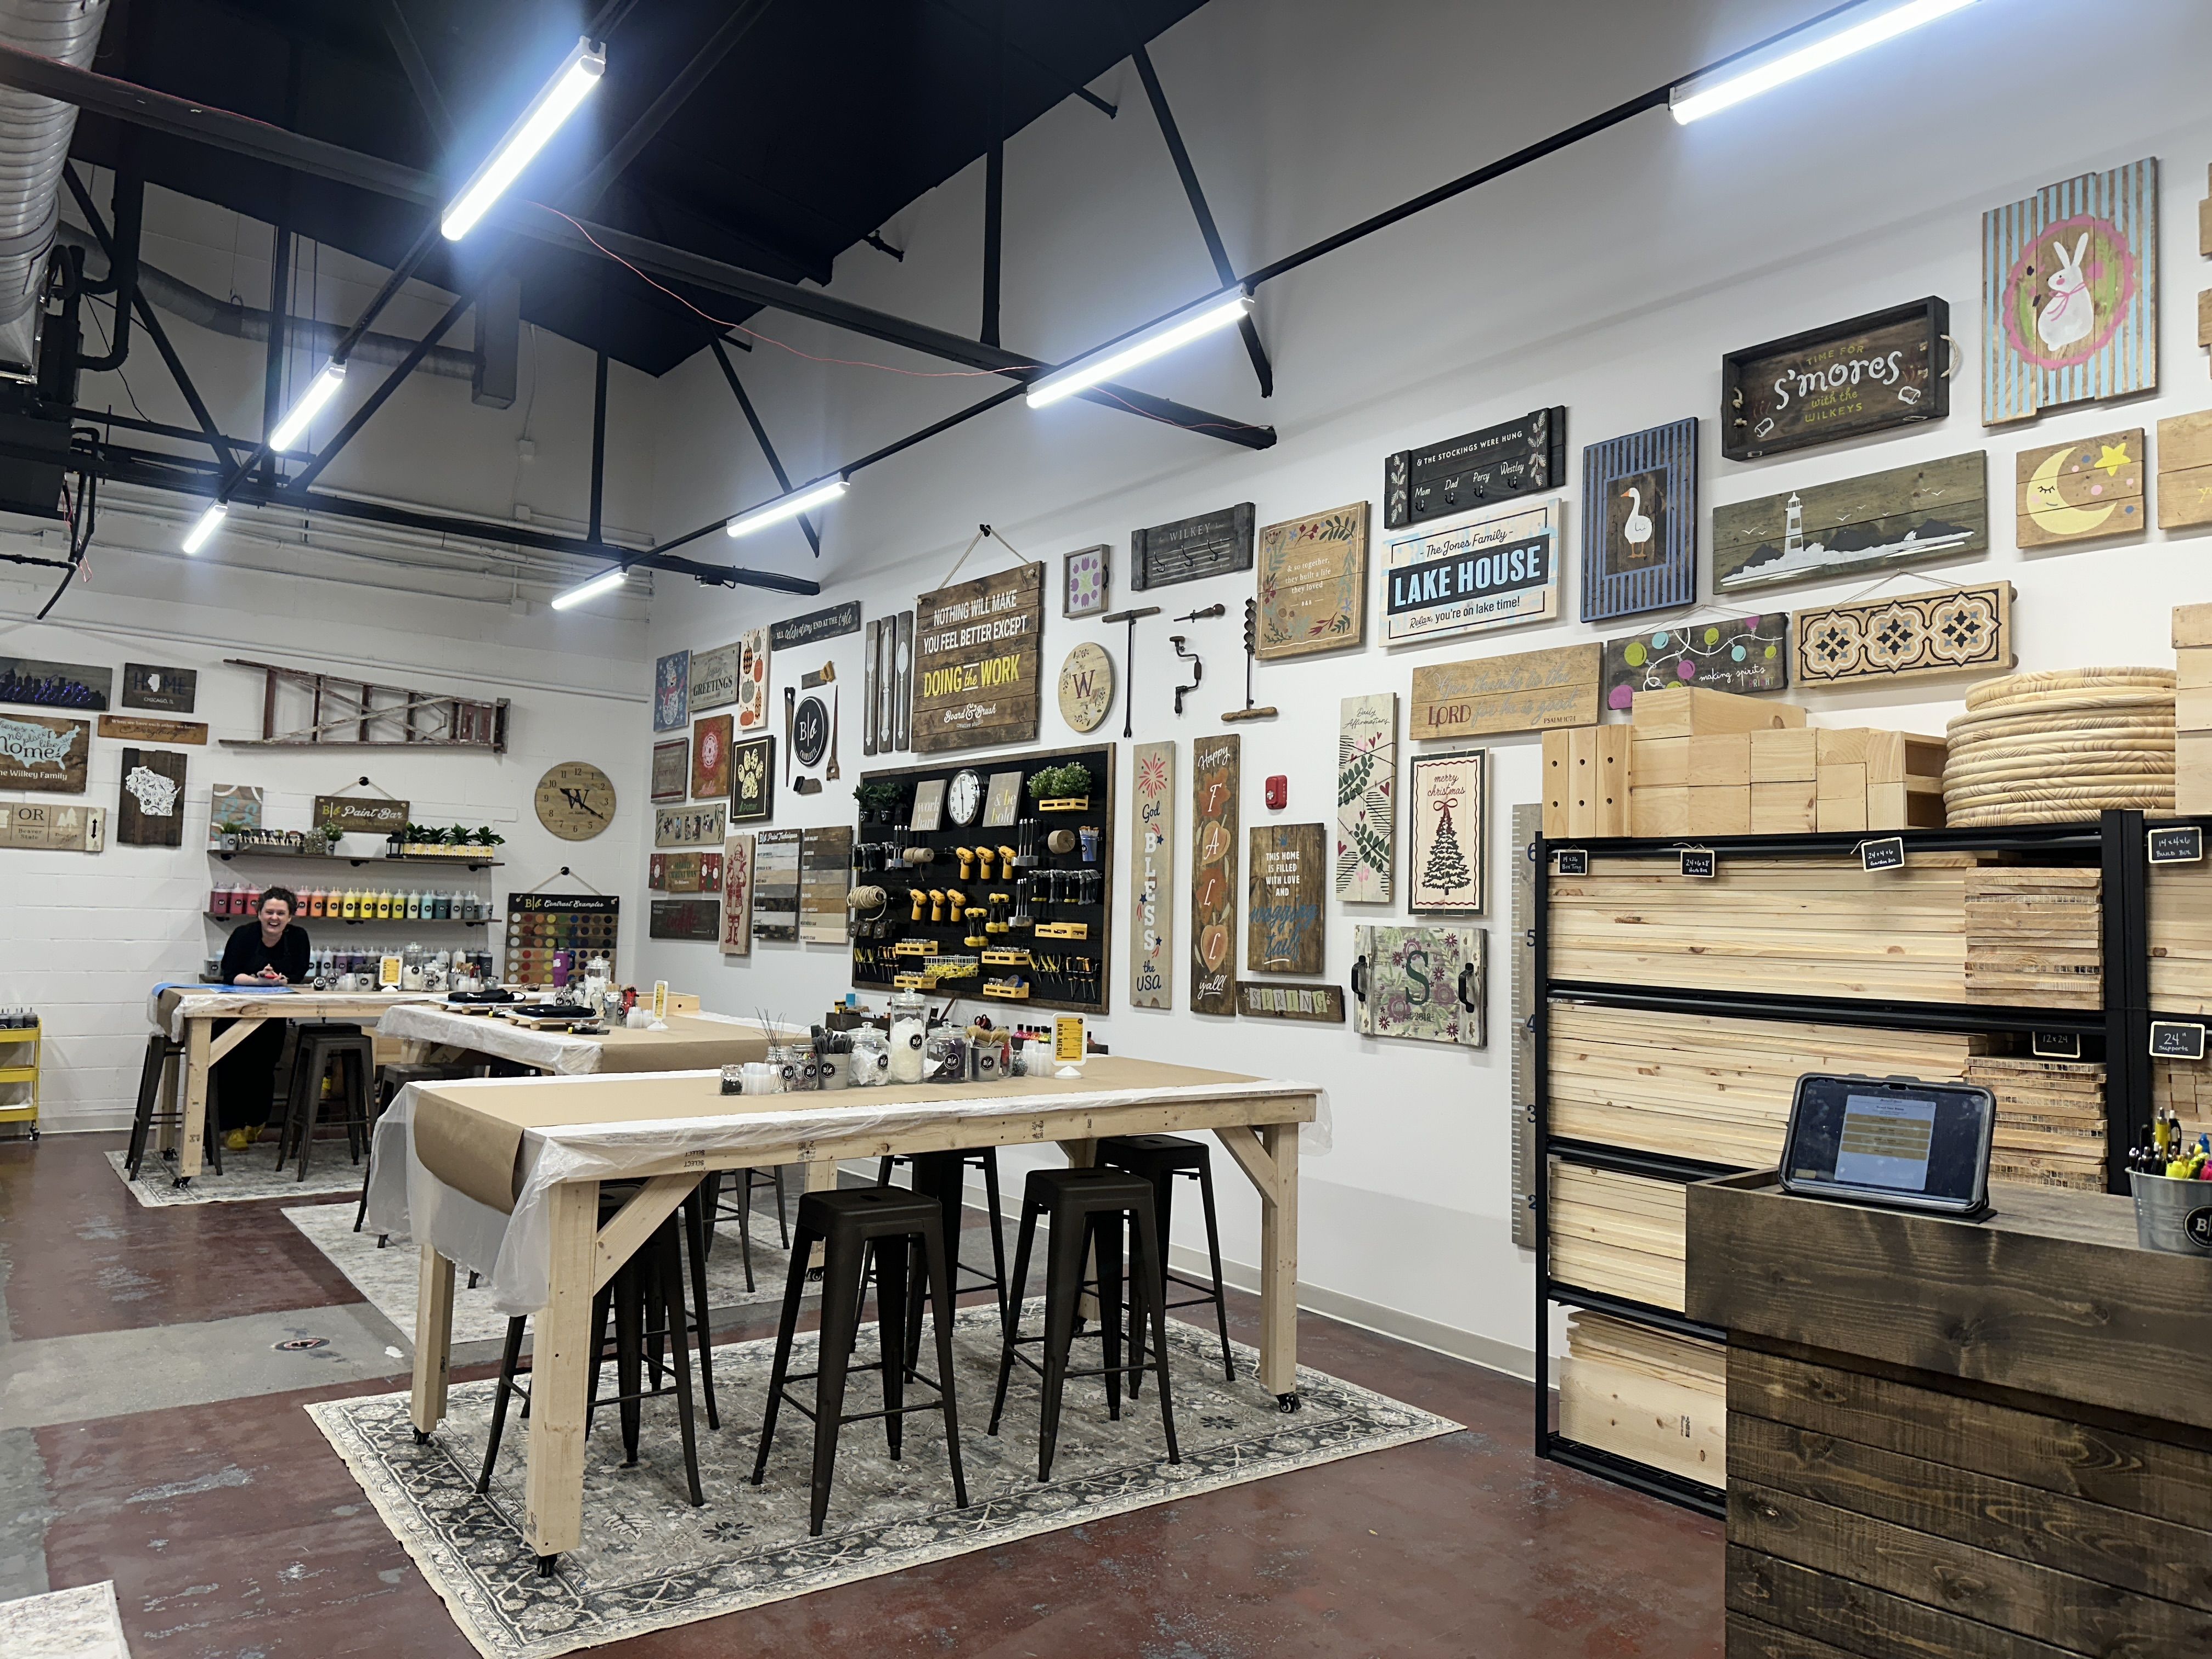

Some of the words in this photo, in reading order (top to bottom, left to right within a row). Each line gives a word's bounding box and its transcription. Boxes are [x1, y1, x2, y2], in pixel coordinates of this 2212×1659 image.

[1806, 350, 1834, 365] TIME
[1840, 345, 1864, 356] FOR
[1812, 391, 1836, 408] with
[1839, 387, 1858, 402] the
[1805, 403, 1863, 422] WILKEYS
[1438, 443, 1477, 461] STOCKINGS
[1480, 437, 1499, 448] WERE
[1502, 431, 1522, 442] HUNG
[1500, 461, 1525, 475] Westley
[1444, 477, 1459, 490] Dad
[1473, 471, 1490, 483] Percy
[1415, 487, 1431, 498] Mom
[1170, 523, 1210, 541] WILKEY
[1426, 545, 1442, 557] The
[1443, 540, 1470, 556] Jones
[1472, 529, 1507, 547] Family
[1302, 558, 1330, 569] together,
[1285, 576, 1299, 584] they
[1300, 571, 1314, 581] built
[1321, 567, 1331, 576] life
[1395, 566, 1451, 607] LAKE
[1458, 545, 1541, 594] HOUSE
[1291, 586, 1305, 594] they
[1306, 580, 1323, 591] loved
[934, 602, 969, 626] NOTHING
[971, 597, 990, 618] WILL
[992, 589, 1017, 612] MAKE
[1409, 616, 1433, 629] Relax,
[1435, 609, 1461, 624] you're
[1463, 607, 1474, 617] on
[1476, 602, 1494, 614] lake
[1497, 596, 1520, 610] time!
[829, 616, 838, 625] THE
[923, 635, 939, 654] YOU
[941, 631, 958, 651] FEEL
[961, 624, 991, 646] BETTER
[994, 615, 1027, 640] EXCEPT
[924, 666, 962, 698] DOING
[964, 668, 977, 687] the
[981, 654, 1020, 688] WORK
[1544, 662, 1572, 687] the
[1699, 668, 1732, 683] making
[1736, 664, 1765, 686] spirits
[693, 675, 732, 696] GREETINGS
[1072, 669, 1096, 699] W
[1357, 707, 1376, 718] Daily
[1427, 704, 1471, 726] LORD
[1544, 715, 1562, 724] PSALM
[1342, 716, 1390, 729] Affirmations
[1198, 746, 1229, 770] Happy
[10, 770, 38, 779] Wilkey
[41, 772, 67, 781] Family
[561, 770, 566, 778] 11
[1434, 774, 1459, 786] merry
[994, 793, 1001, 806] &
[1004, 789, 1015, 806] be
[1427, 783, 1465, 797] christmas
[342, 805, 376, 818] Paint
[377, 808, 403, 820] Bar
[917, 797, 939, 812] work
[1142, 800, 1160, 823] God
[19, 808, 44, 821] OR
[917, 813, 937, 829] hard
[991, 806, 1014, 823] bold
[1266, 853, 1279, 861] THIS
[1282, 851, 1300, 860] HOME
[1268, 865, 1274, 873] IS
[1276, 864, 1297, 872] FILLED
[1266, 876, 1282, 885] WITH
[1284, 876, 1300, 884] LOVE
[1276, 888, 1289, 896] AND
[1265, 923, 1301, 962] tails
[1143, 961, 1155, 973] the
[1137, 975, 1161, 991] USA
[1406, 950, 1430, 1005] S
[1198, 975, 1227, 999] y'all!
[1252, 991, 1324, 1011] SPRING
